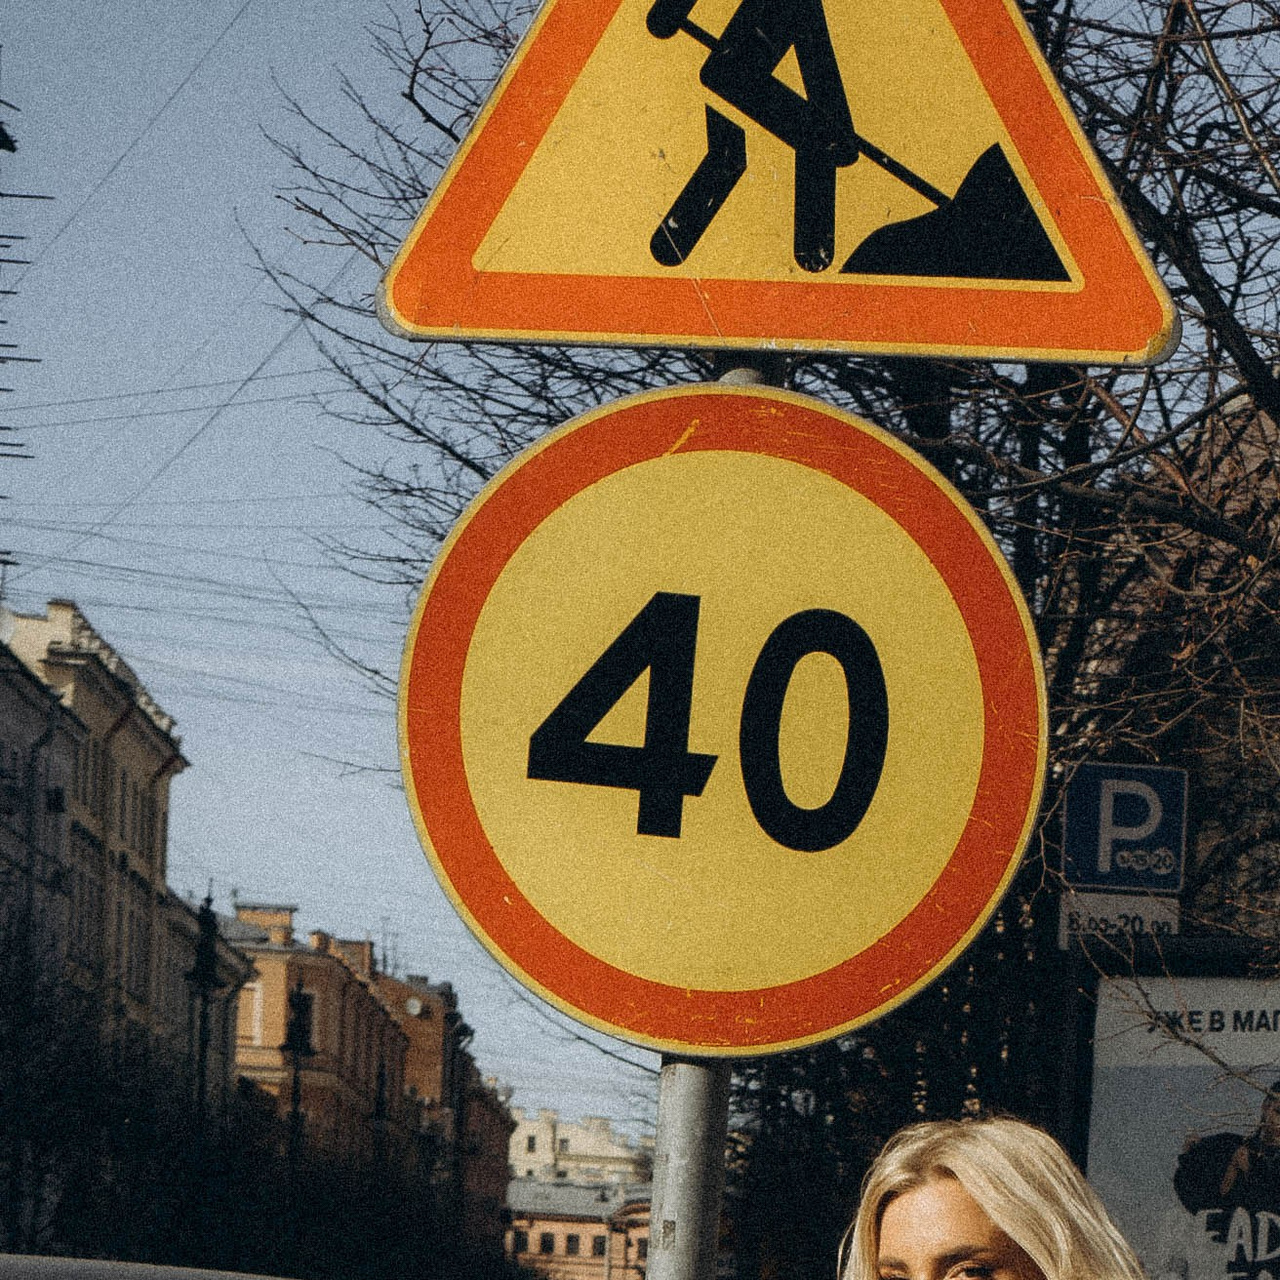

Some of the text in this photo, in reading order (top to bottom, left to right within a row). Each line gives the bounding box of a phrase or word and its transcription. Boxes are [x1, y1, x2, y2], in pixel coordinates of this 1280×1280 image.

[527, 591, 889, 853] 40
[1097, 779, 1163, 873] P
[1208, 1010, 1225, 1032] В
